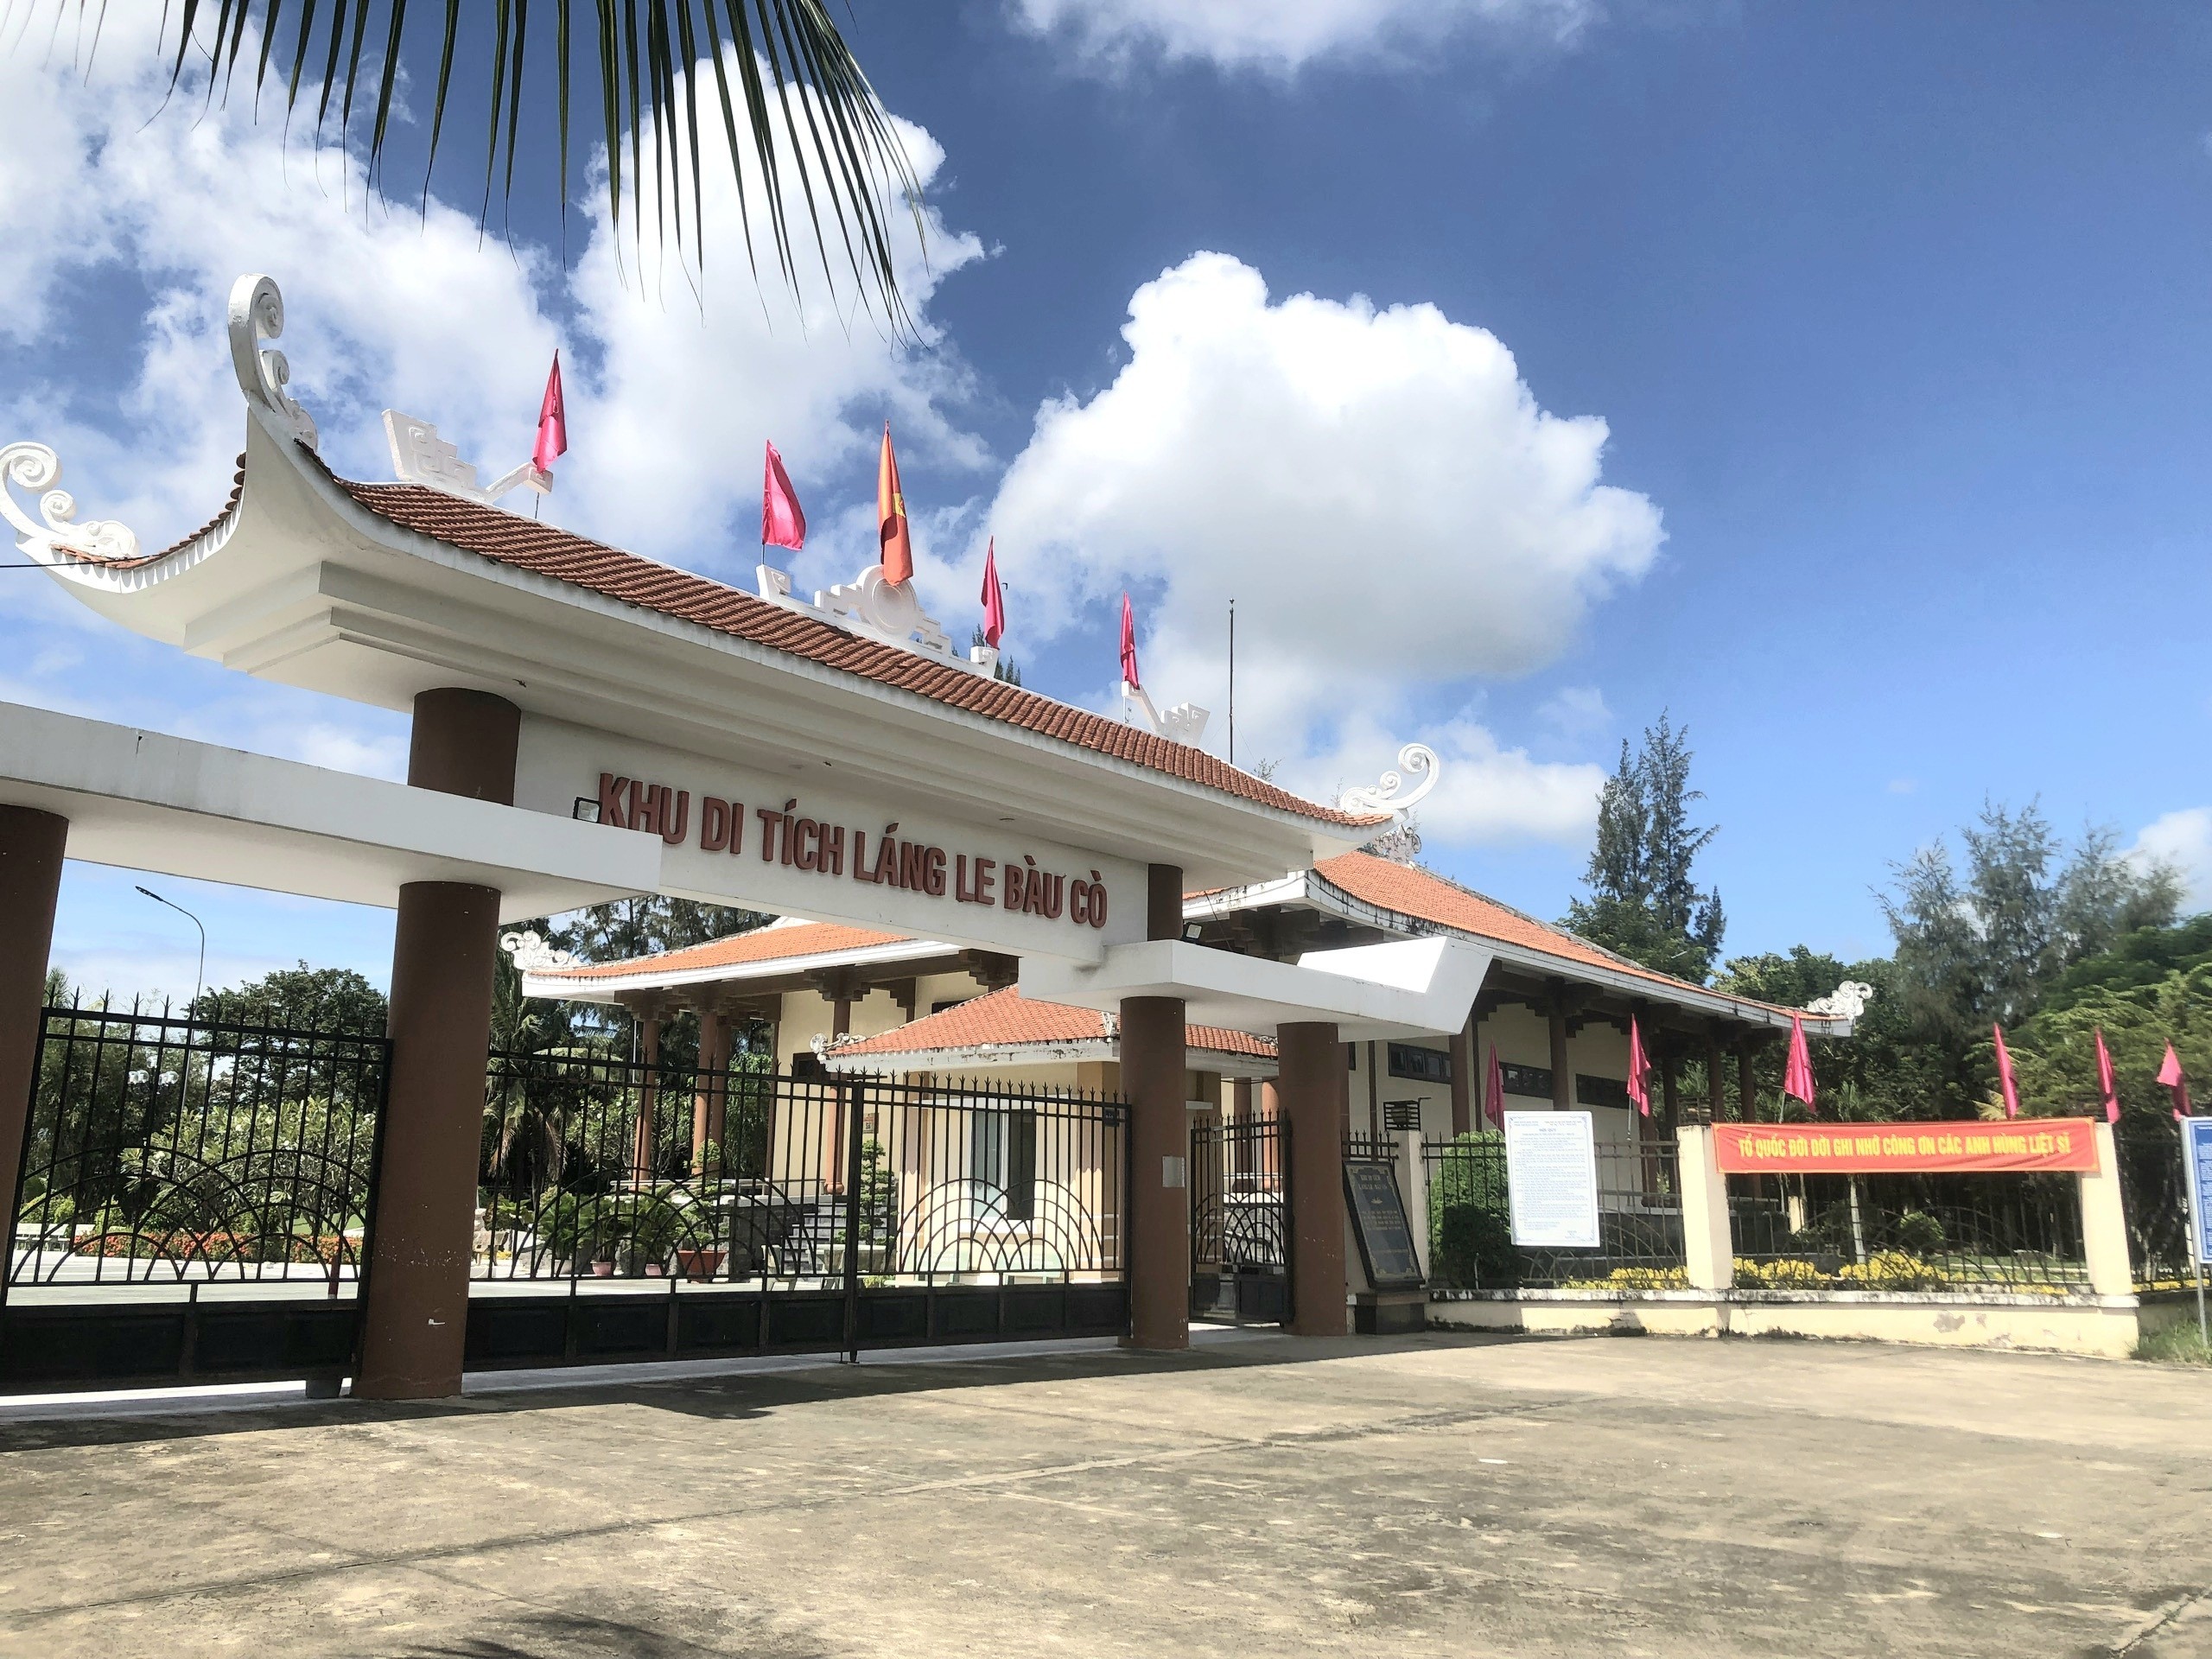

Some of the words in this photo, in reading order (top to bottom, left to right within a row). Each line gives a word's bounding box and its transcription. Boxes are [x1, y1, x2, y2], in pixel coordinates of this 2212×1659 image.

[599, 773, 690, 844] KHU
[701, 797, 744, 855] DI
[757, 798, 845, 875] TÍCH
[854, 823, 946, 896] LÁNG
[956, 855, 996, 906] LE
[1004, 855, 1064, 918] BÀU
[1071, 870, 1108, 928] CÒ
[1834, 1138, 1853, 1156] GHI
[1883, 1134, 1916, 1156] CÔNG
[1937, 1133, 1962, 1155] CÁC
